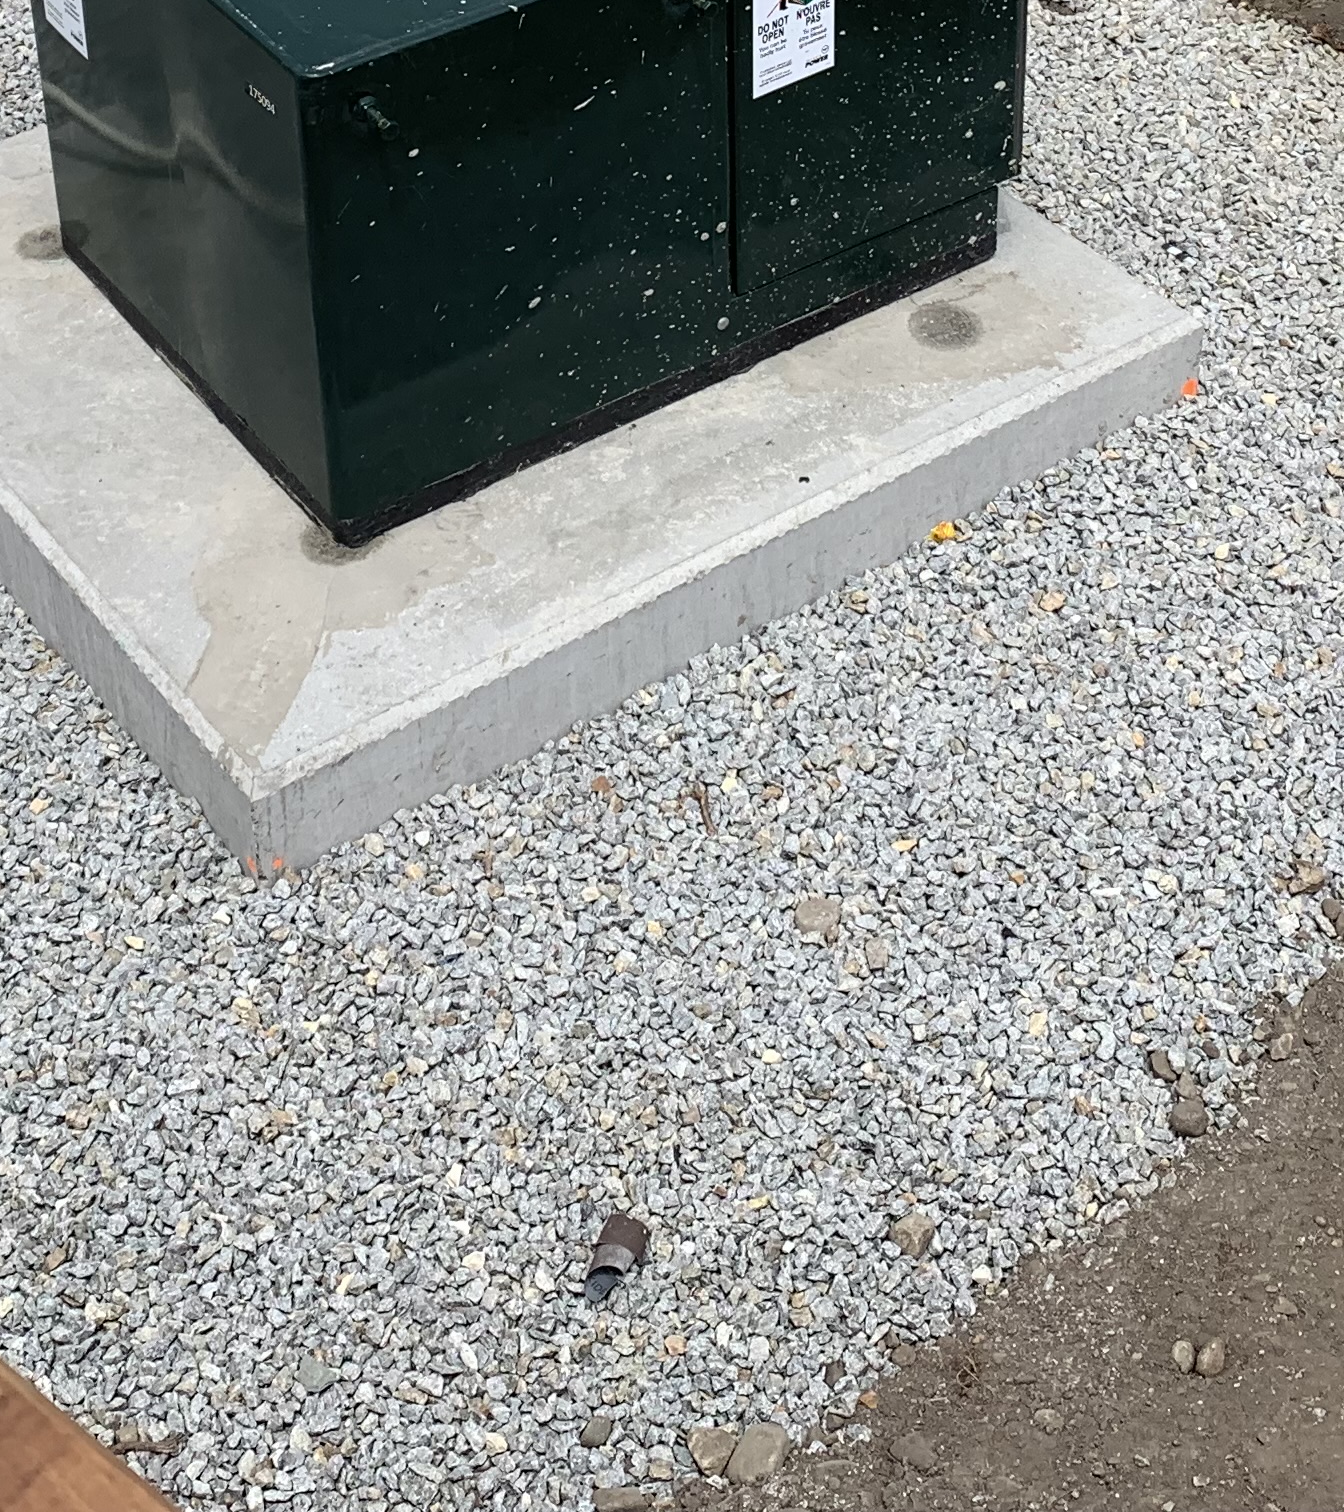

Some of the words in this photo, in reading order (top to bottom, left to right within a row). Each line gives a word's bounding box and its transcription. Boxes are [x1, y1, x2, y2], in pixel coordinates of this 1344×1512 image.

[758, 23, 770, 36] DO
[772, 14, 789, 30] NOT
[805, 12, 821, 26] PAS
[762, 27, 785, 44] OPEN
[248, 84, 275, 115] 175094
